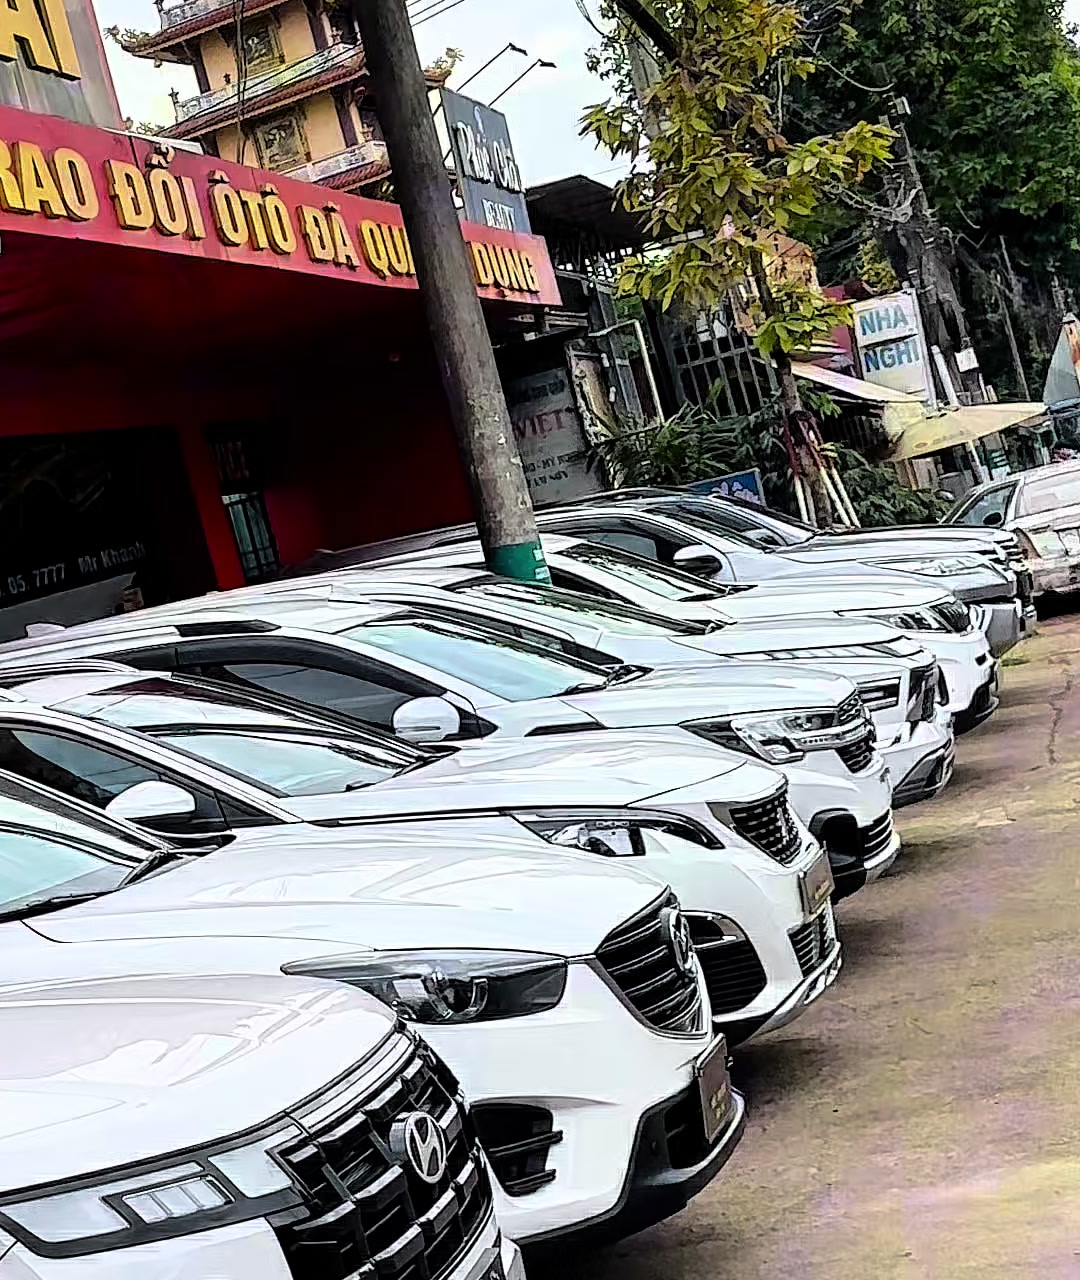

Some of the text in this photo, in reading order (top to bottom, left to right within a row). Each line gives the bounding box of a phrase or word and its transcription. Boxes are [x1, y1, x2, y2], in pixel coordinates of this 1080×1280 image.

[105, 143, 206, 241] ĐỔI
[208, 170, 297, 255] ÔTÔ
[296, 201, 360, 271] ĐÃ
[358, 219, 417, 280] QU
